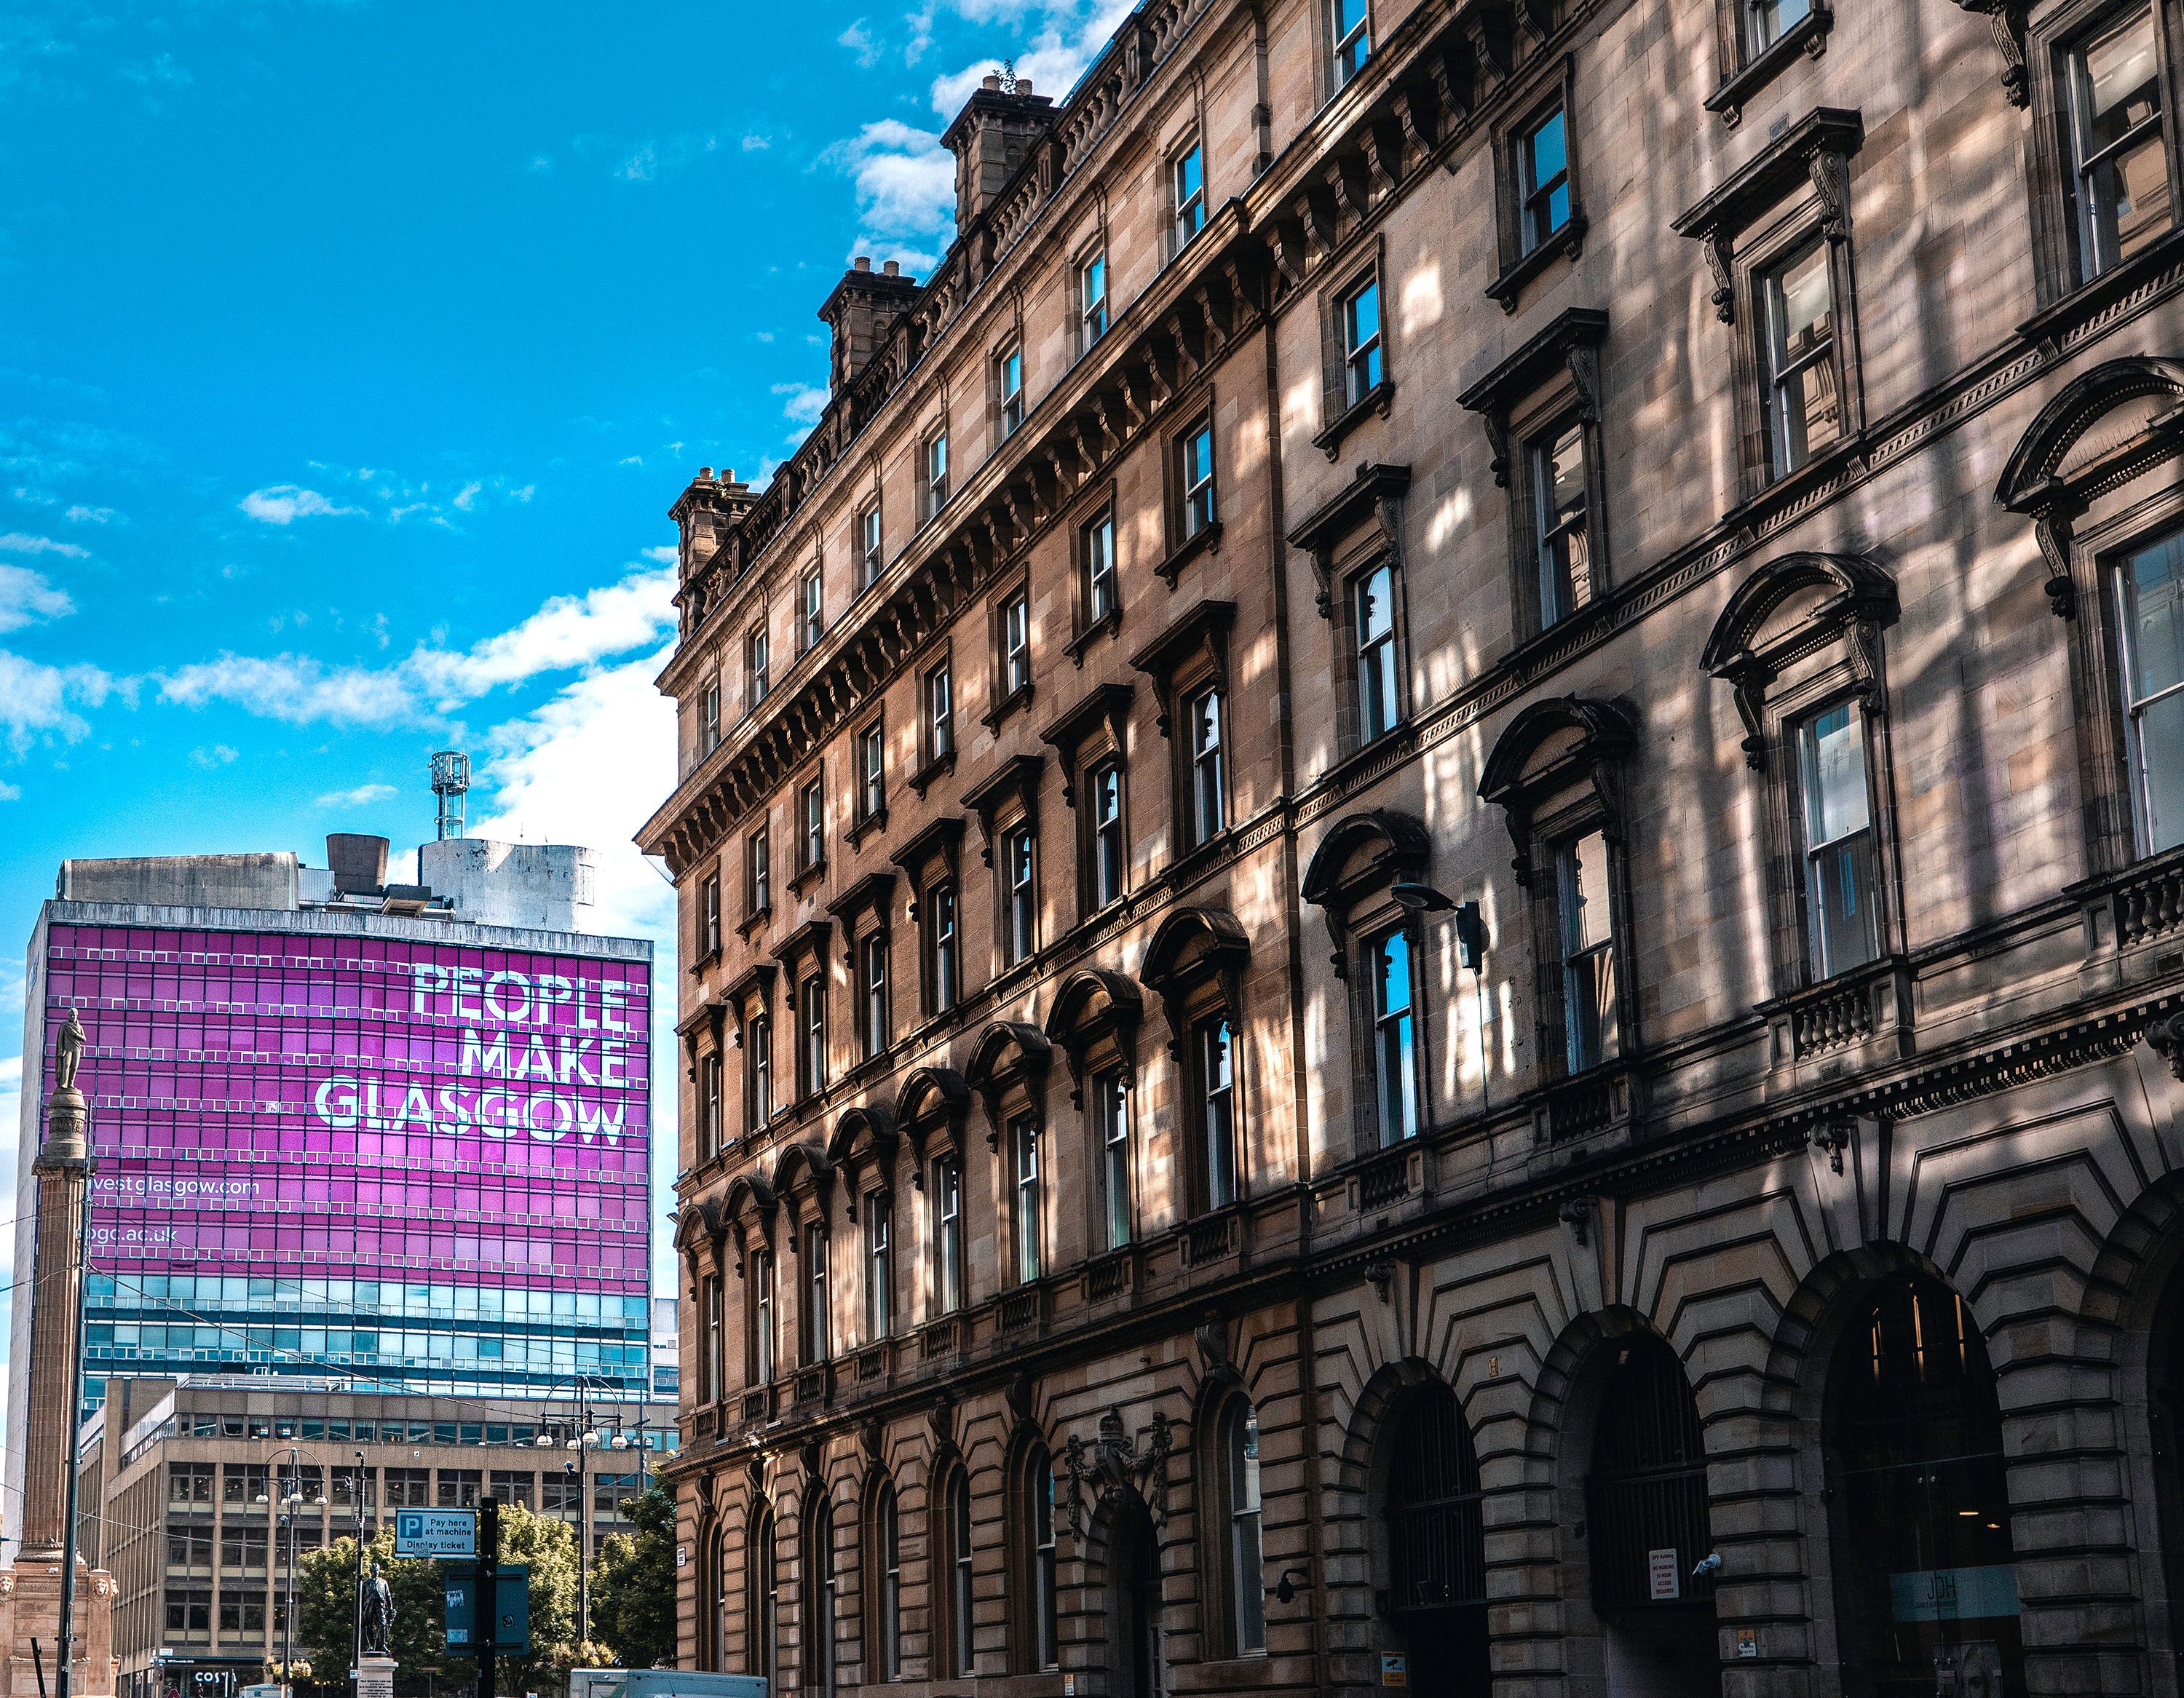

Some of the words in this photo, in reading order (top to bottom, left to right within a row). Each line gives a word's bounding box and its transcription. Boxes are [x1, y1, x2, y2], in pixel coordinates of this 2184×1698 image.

[413, 962, 632, 1032] PEOPLE
[461, 1028, 631, 1090] MAKE
[314, 1074, 630, 1146] GLASGOW
[430, 1519, 446, 1527] Pay
[448, 1519, 467, 1527] here
[440, 1541, 465, 1550] ticket
[1928, 1576, 1957, 1600] JDH
